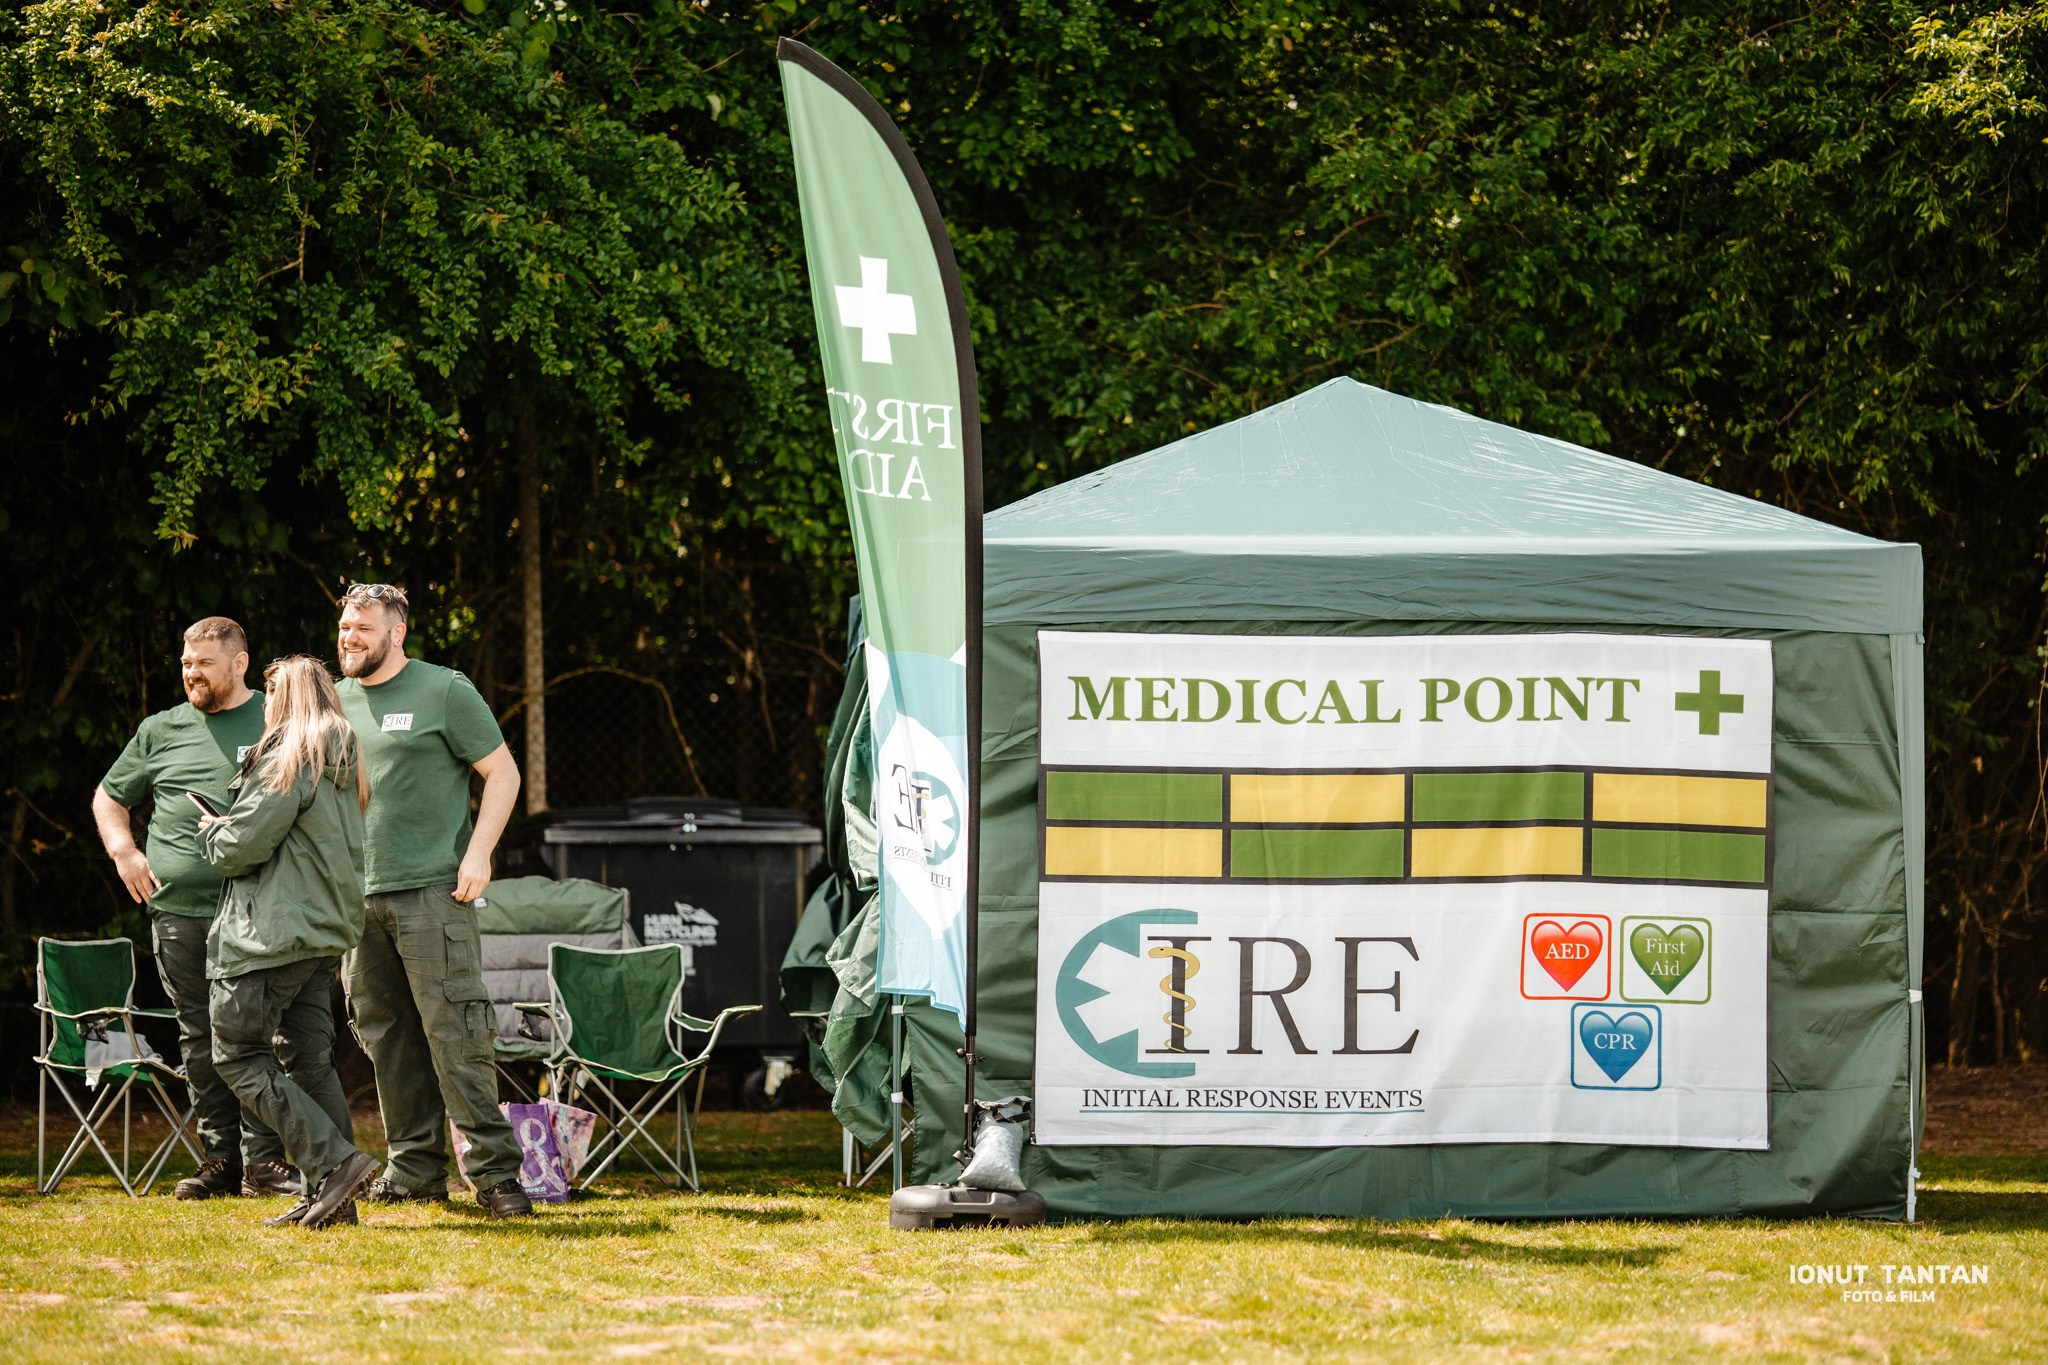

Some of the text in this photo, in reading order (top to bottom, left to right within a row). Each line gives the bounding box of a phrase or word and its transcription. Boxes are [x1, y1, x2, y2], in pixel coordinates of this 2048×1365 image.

[1067, 676, 1640, 724] MEDICAL POINT
[644, 925, 717, 938] RECYCLING
[1545, 943, 1590, 960] AED
[1645, 938, 1686, 955] First
[1650, 961, 1681, 976] Aid
[1594, 1033, 1637, 1050] CPR
[1082, 1088, 1423, 1109] INITIAL RESPONSE EVENTS
